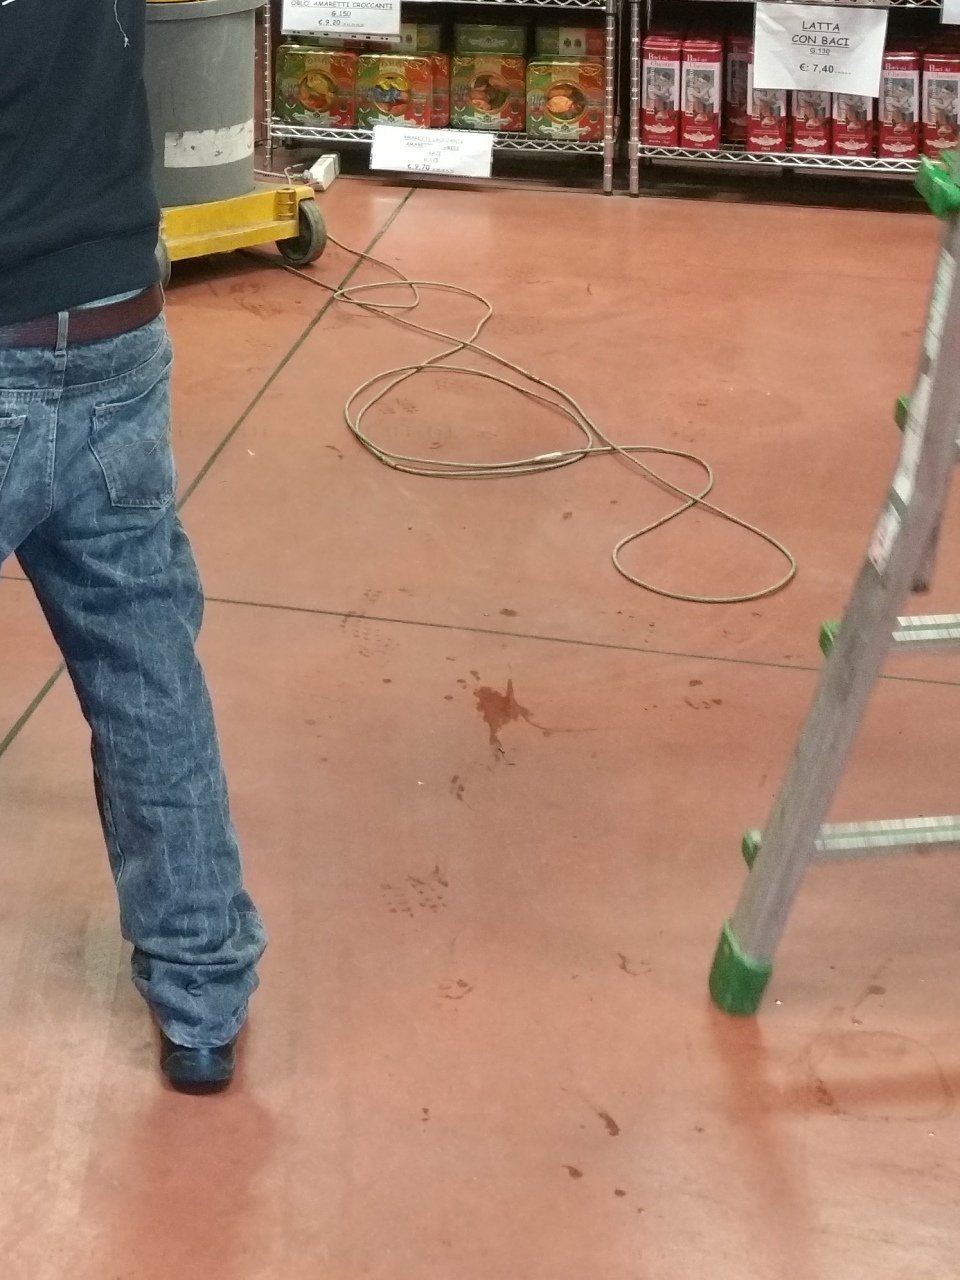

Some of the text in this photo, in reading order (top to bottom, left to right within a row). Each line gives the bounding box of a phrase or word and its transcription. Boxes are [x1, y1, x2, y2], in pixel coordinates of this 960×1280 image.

[802, 21, 840, 31] LATTA
[791, 34, 850, 47] CON BACI
[812, 64, 835, 74] 7,40
